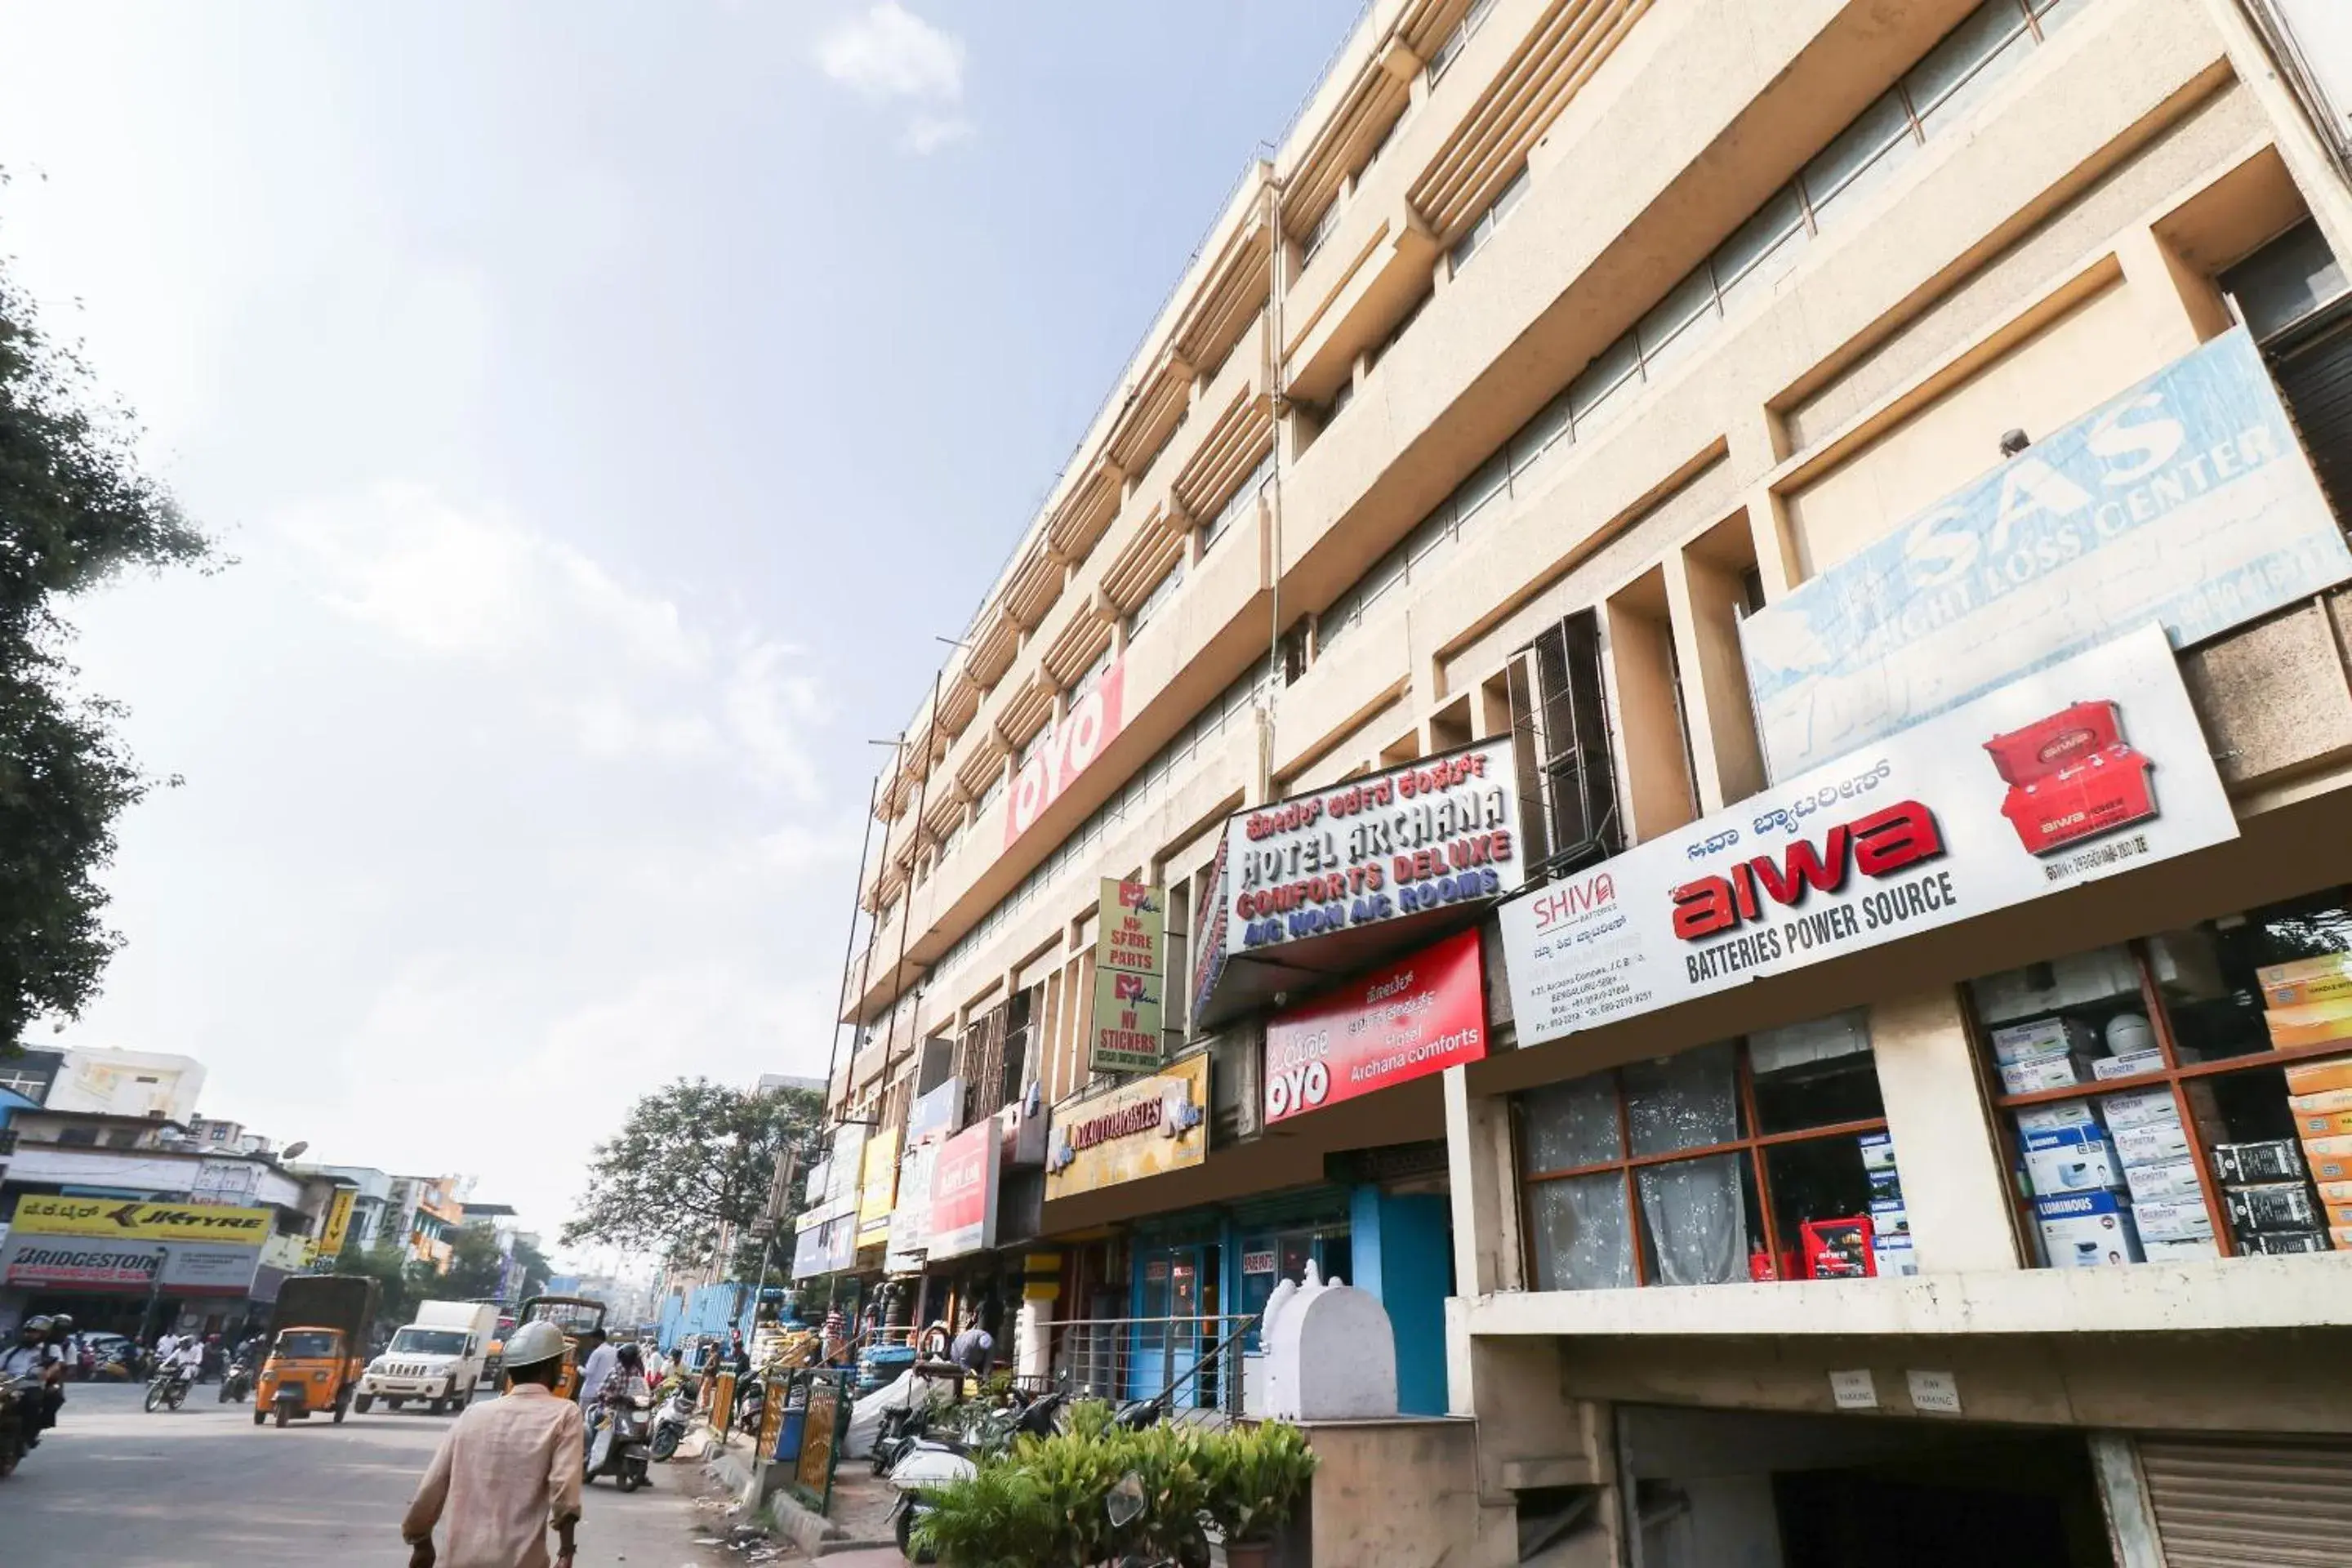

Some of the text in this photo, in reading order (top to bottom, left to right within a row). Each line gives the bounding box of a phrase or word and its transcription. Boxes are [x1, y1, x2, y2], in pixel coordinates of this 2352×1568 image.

[1904, 390, 2185, 586] SAS
[1989, 521, 2082, 595] LOSS
[2096, 422, 2280, 537] CENTER
[1016, 691, 1102, 834] OYO
[1241, 783, 1505, 890] HOTEL ARCHANA
[1236, 829, 1512, 920] COMFORTS DELUXE
[1533, 872, 1616, 929] SHIVA
[1669, 800, 1944, 941] aiwa
[1289, 903, 1345, 939] NON
[1398, 868, 1500, 913] ROOMS
[1686, 871, 1958, 984] BATTERIES POWER SOURCE
[1109, 949, 1153, 970] PARTS
[1100, 1027, 1156, 1054] STICKERS
[1121, 1009, 1138, 1031] NV
[1351, 1027, 1479, 1084] Archana comforts
[1267, 1062, 1330, 1116] OYO
[2040, 1196, 2092, 1215] LUMINOUS
[13, 1246, 162, 1271] BRIDGESTON
